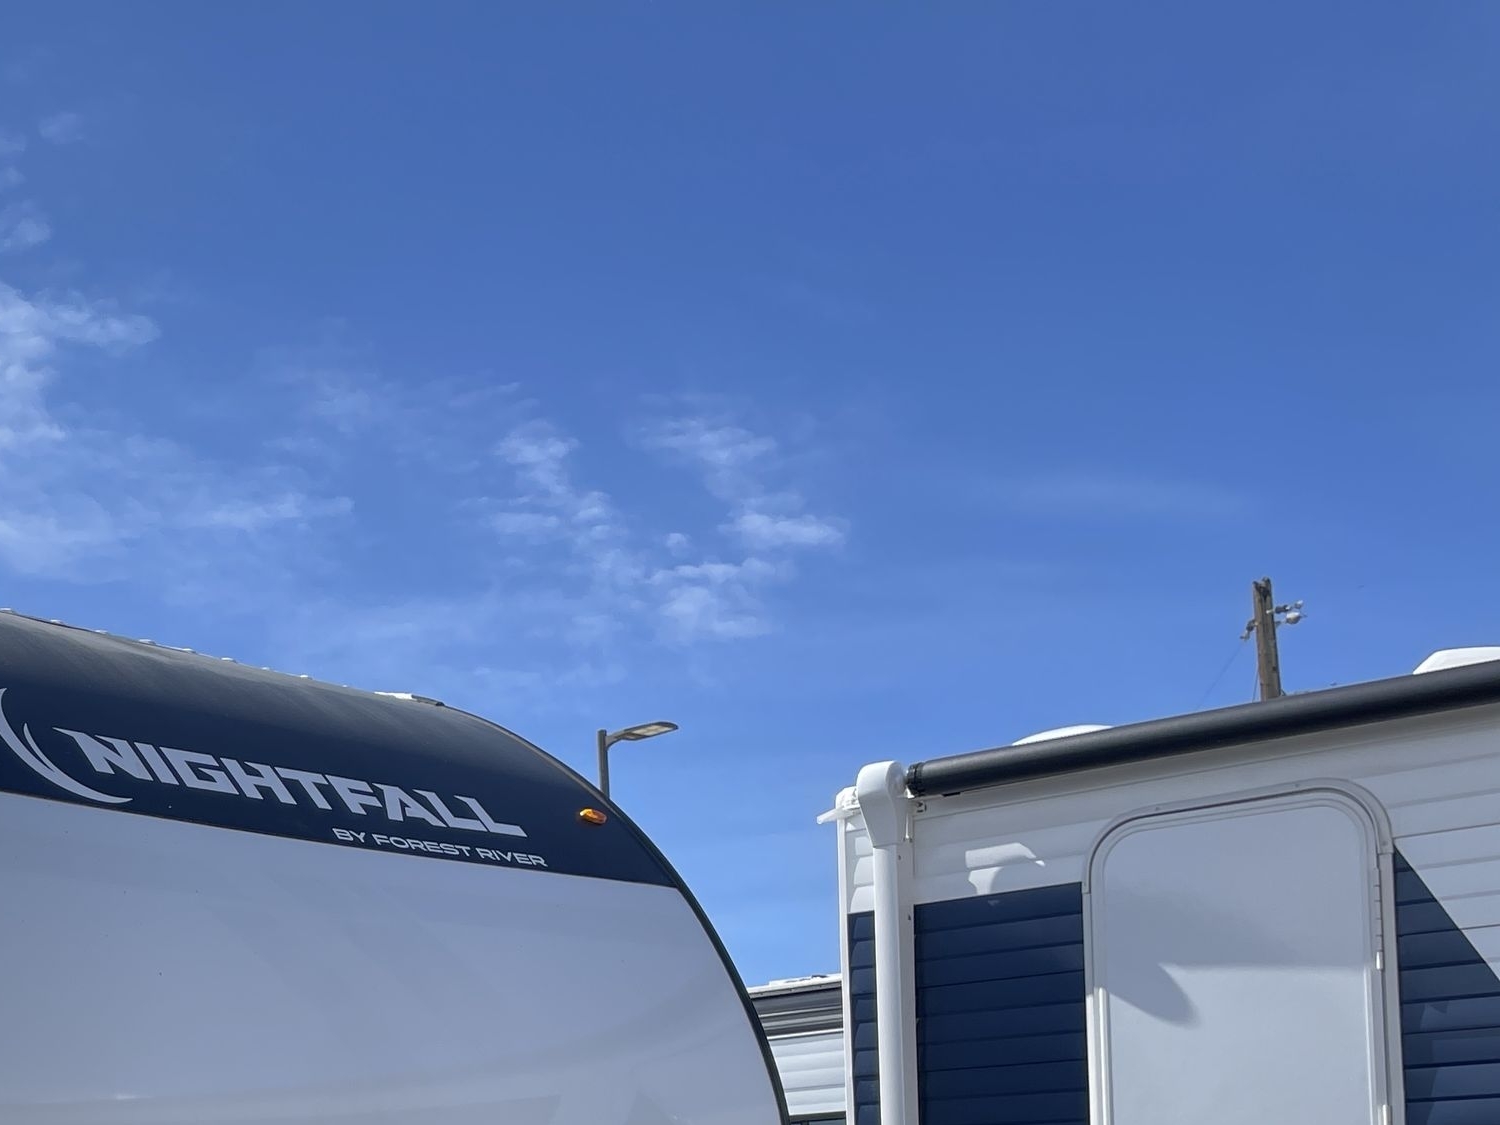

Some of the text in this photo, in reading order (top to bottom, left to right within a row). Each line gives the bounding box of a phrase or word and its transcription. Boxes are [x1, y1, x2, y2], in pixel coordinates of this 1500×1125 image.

[53, 727, 527, 837] NIGHTFALL
[332, 828, 548, 867] BY FOREST RIVER
